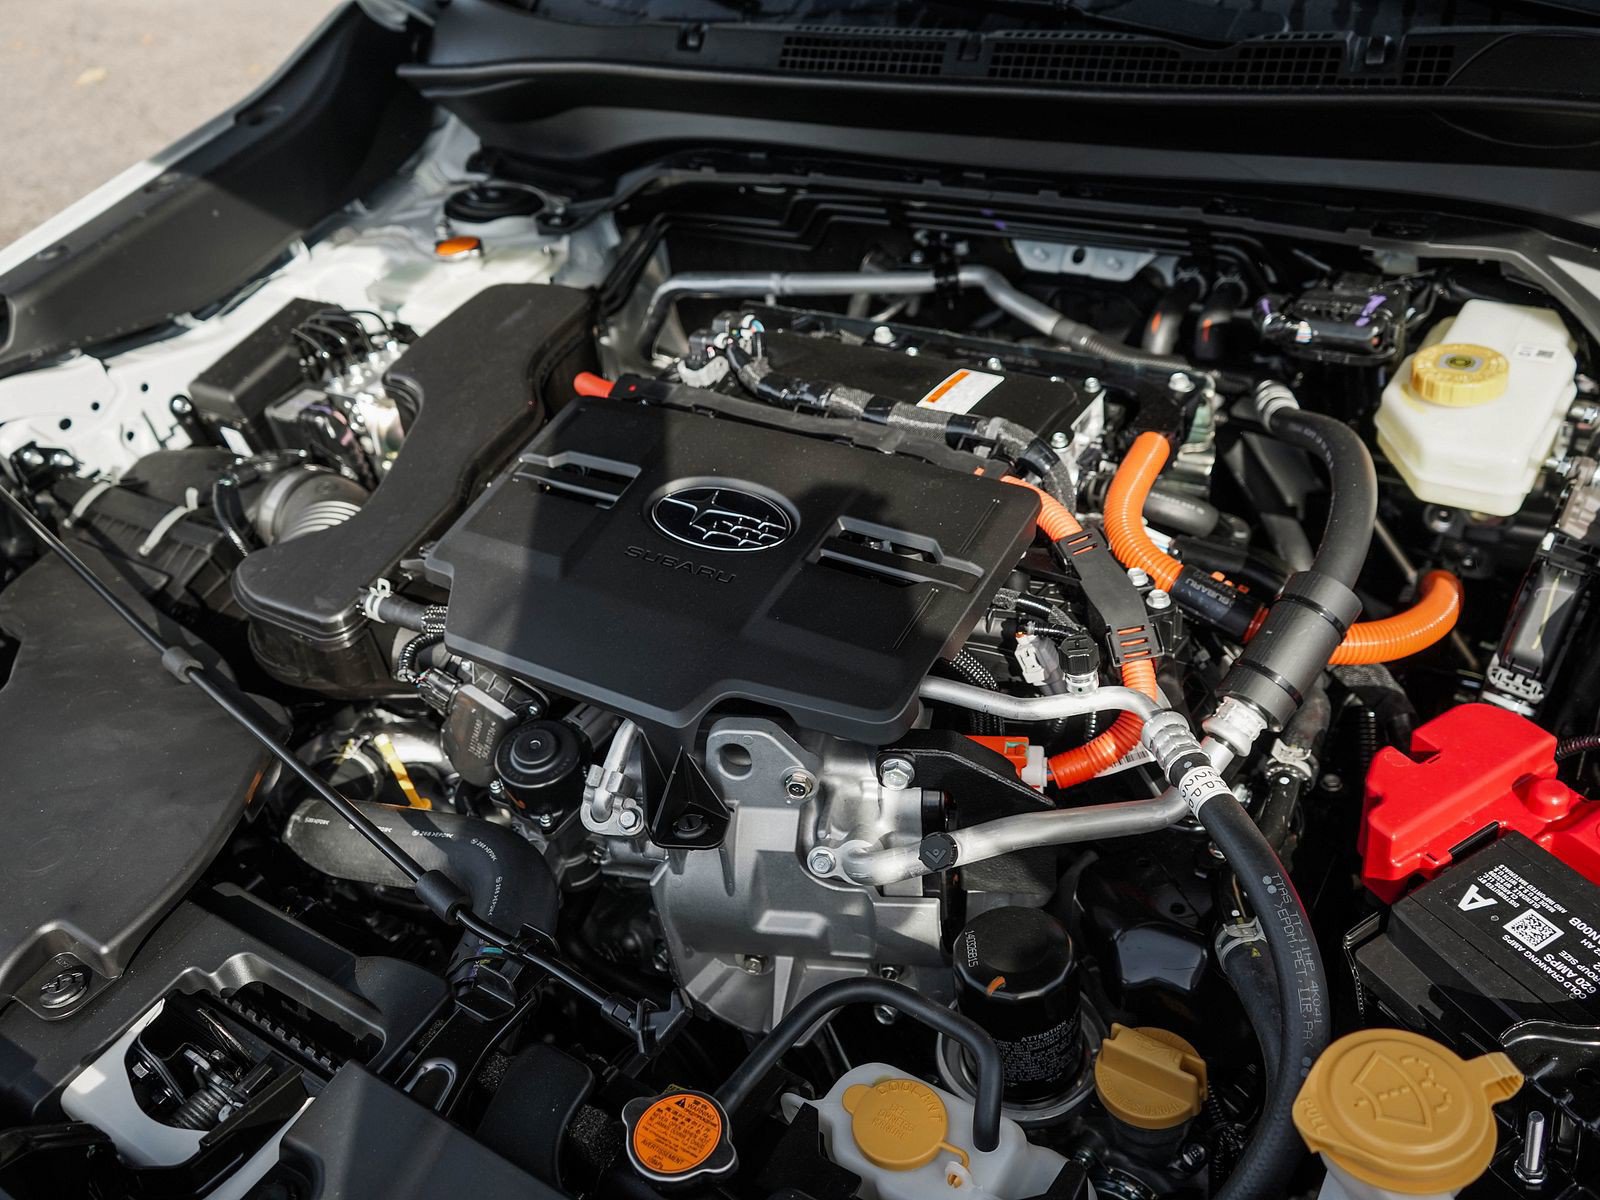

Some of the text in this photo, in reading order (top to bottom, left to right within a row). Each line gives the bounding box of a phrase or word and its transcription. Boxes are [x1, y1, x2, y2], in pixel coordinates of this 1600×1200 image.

[624, 545, 736, 583] SUBARU
[1184, 578, 1231, 606] SUBARU
[1183, 778, 1202, 799] 2P
[1194, 771, 1215, 790] 2P
[1271, 872, 1292, 903] TTAS
[1477, 875, 1520, 908] DISTRIBUTED BY:
[1499, 864, 1567, 914] AND IMPORTED MATERIALS
[1502, 874, 1518, 886] WITH
[1504, 881, 1513, 889] WI
[1457, 883, 1498, 911] A
[1540, 899, 1557, 913] MADE
[1569, 917, 1600, 945] N00B
[1580, 938, 1596, 949] AH
[1502, 934, 1587, 999] COLD CRANKING AMPS
[1558, 950, 1579, 965] SIZE
[1543, 953, 1597, 994] 620 AMPS
[1021, 1020, 1067, 1042] ATTENTION
[686, 1102, 715, 1121] WARNING
[877, 1081, 943, 1122] COOLANT
[652, 1111, 668, 1123] NEVER
[667, 1120, 682, 1130] OPEN
[682, 1128, 697, 1139] WHEN
[1300, 1097, 1329, 1135] PULL
[640, 1138, 684, 1165] AVERTISSEMENT
